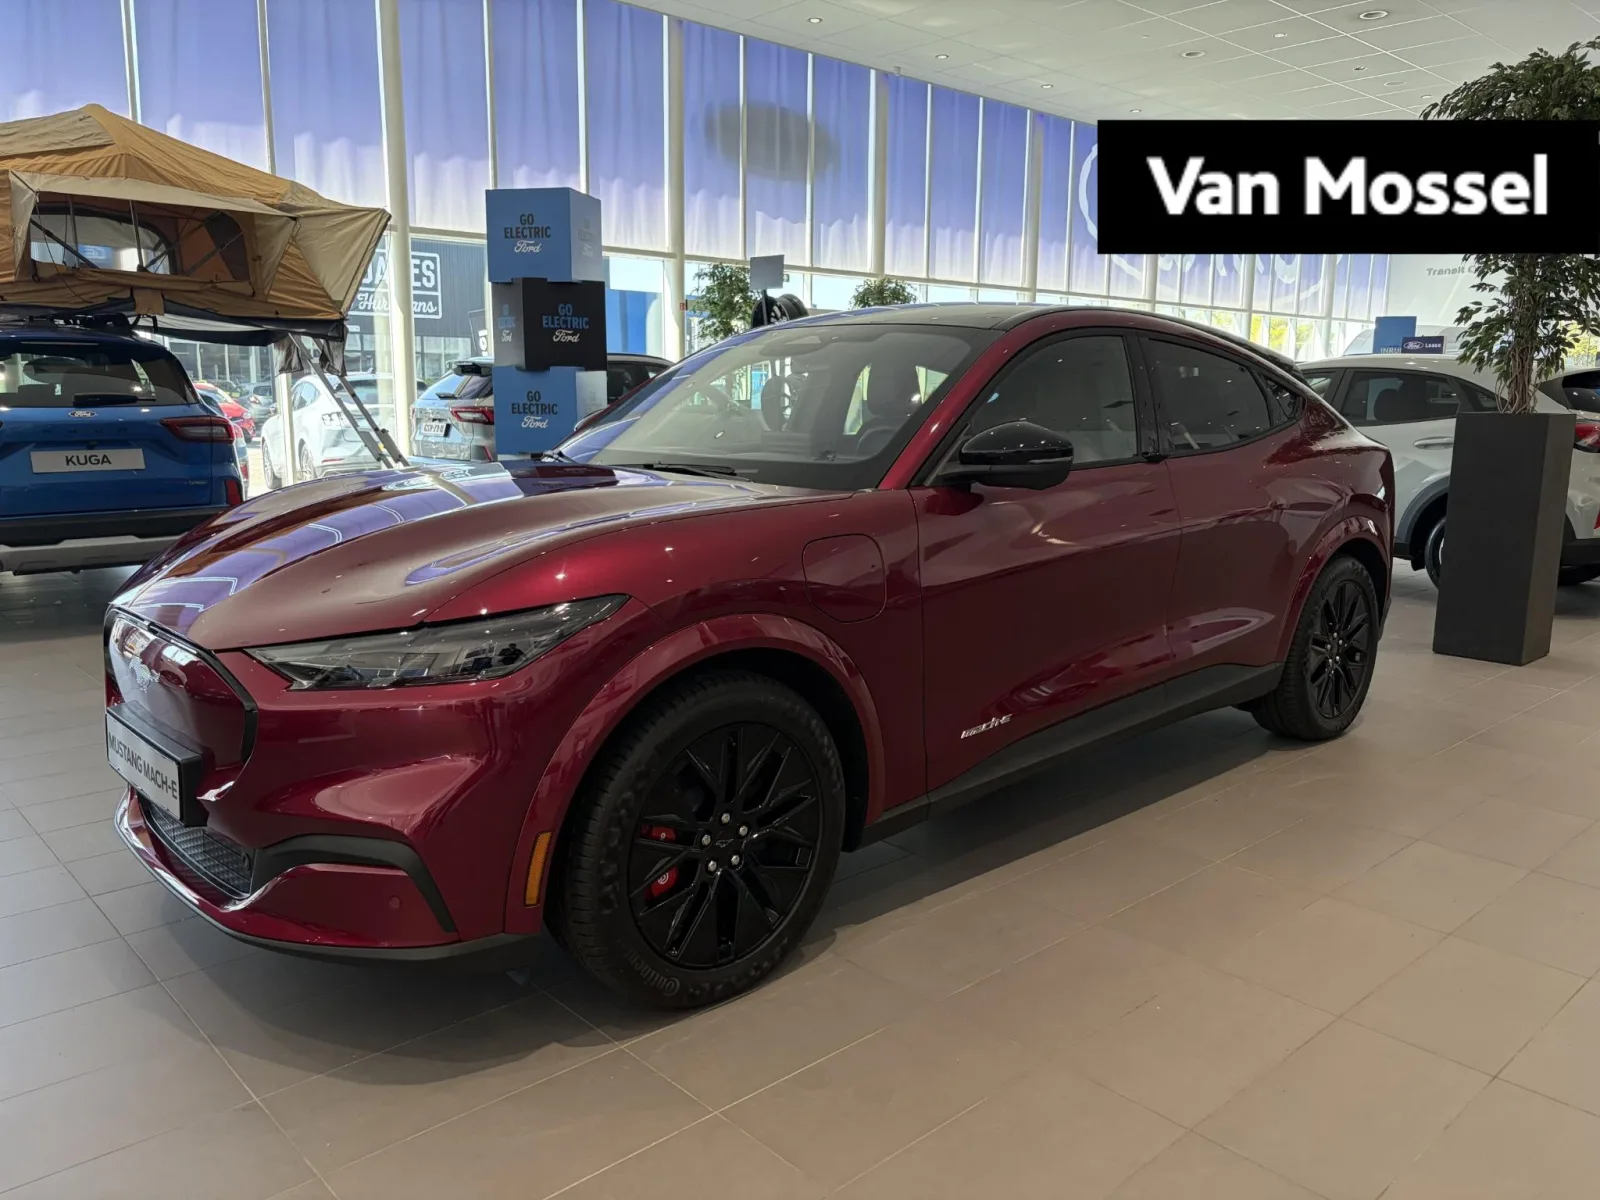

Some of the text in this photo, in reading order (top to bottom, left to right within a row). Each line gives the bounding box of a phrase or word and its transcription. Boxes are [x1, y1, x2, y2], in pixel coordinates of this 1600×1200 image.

[519, 213, 535, 226] GO
[503, 226, 552, 239] ELECTRIC
[513, 240, 543, 254] Ford
[1426, 265, 1465, 277] Transit
[557, 303, 574, 317] GO
[541, 315, 590, 330] ELECTRIC
[551, 329, 580, 343] Ford
[526, 390, 542, 403] GO
[510, 402, 559, 416] ELECTRIC
[520, 415, 549, 430] Ford
[64, 454, 112, 467] KUGA
[108, 730, 178, 801] MUSTANG MACH-E
